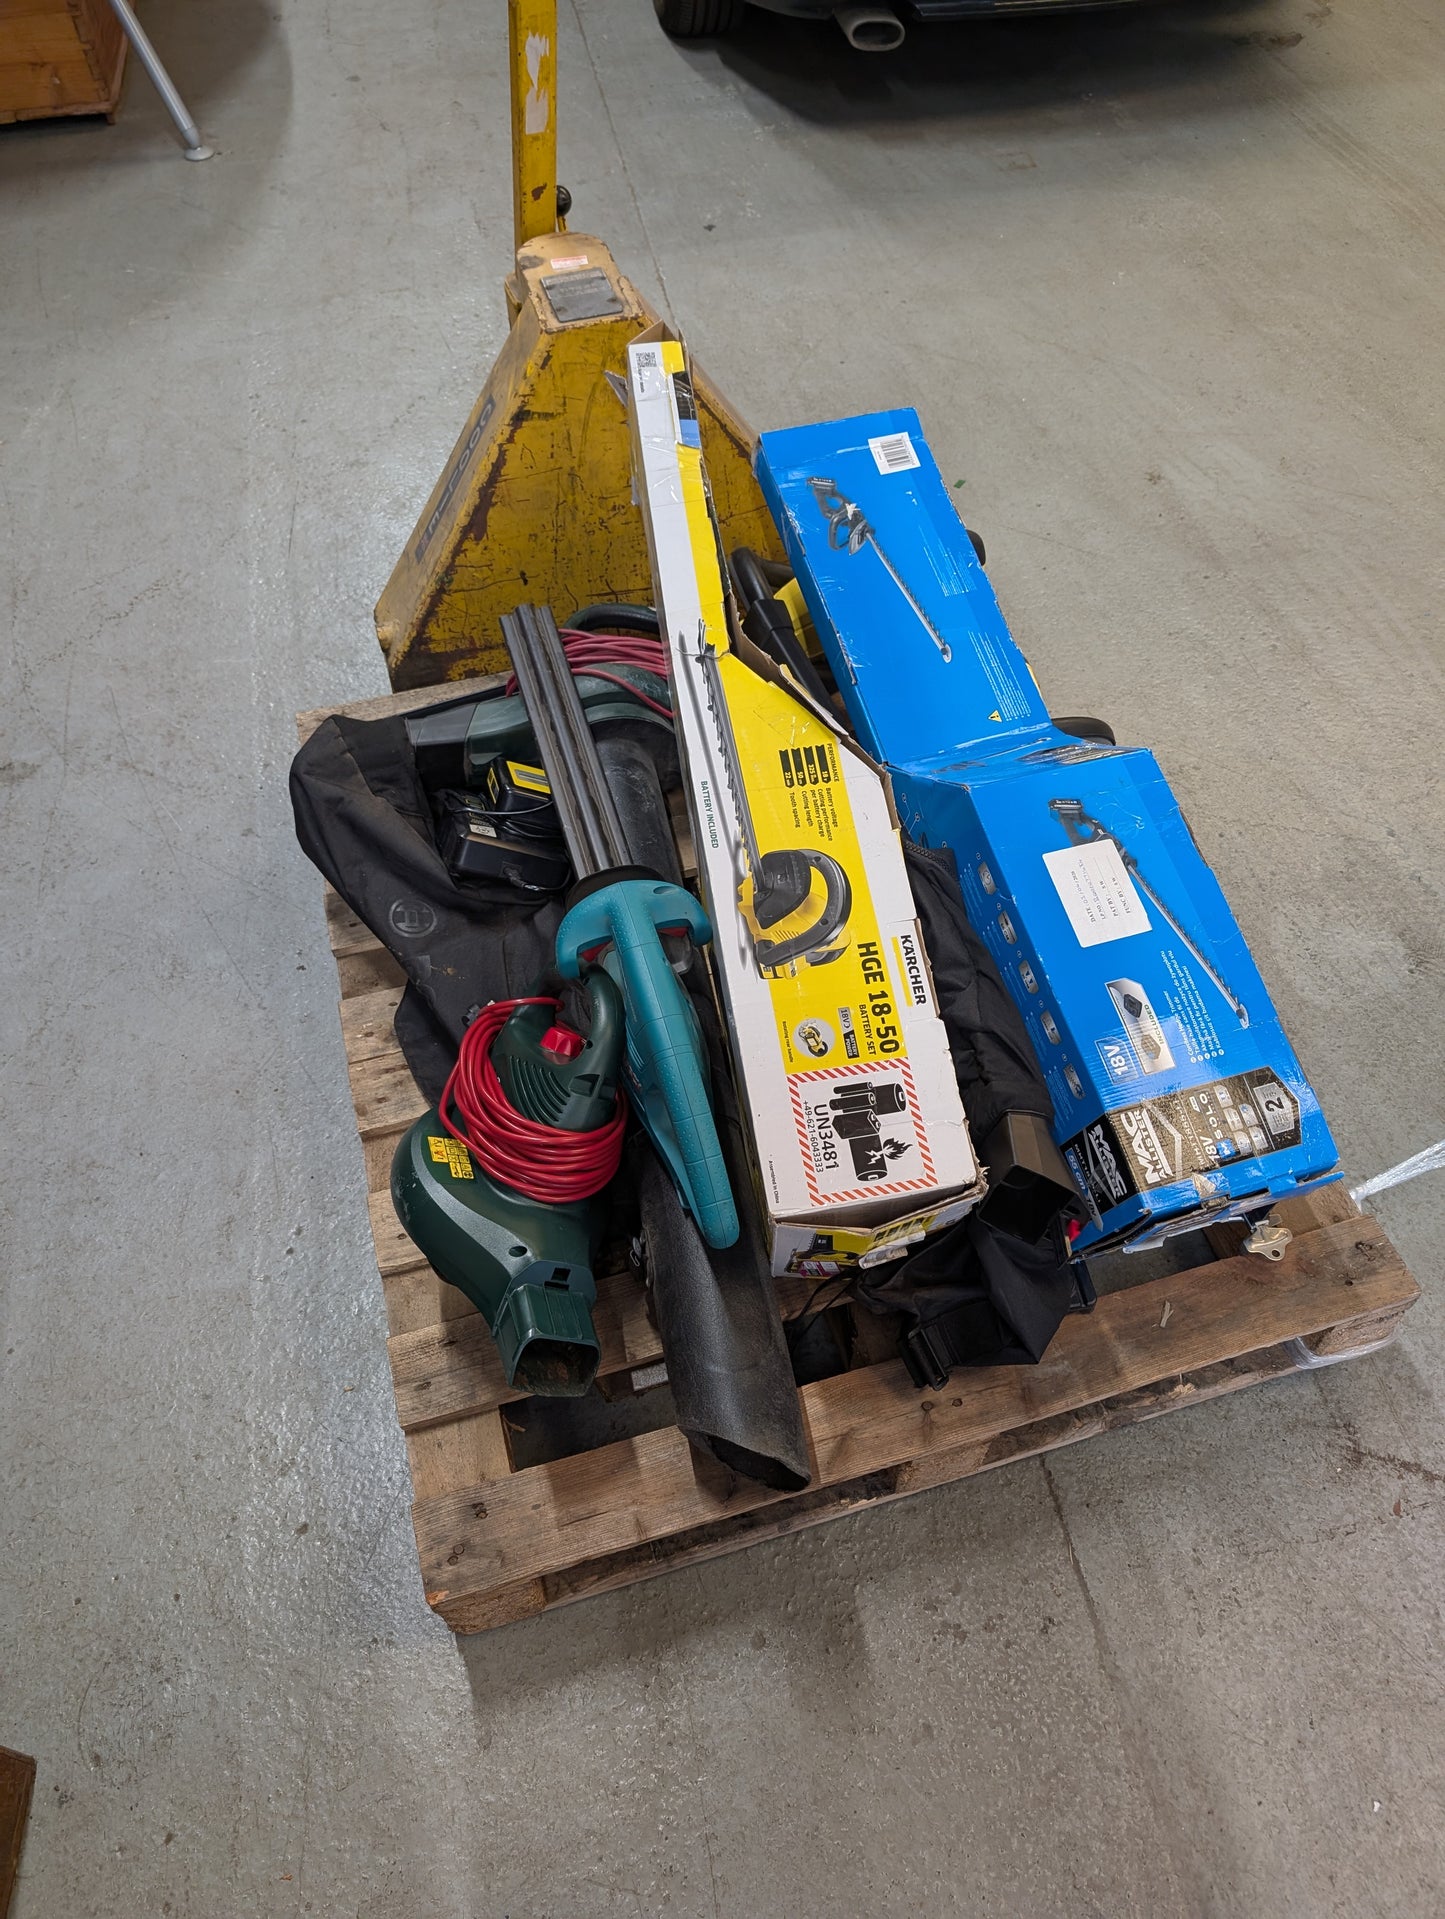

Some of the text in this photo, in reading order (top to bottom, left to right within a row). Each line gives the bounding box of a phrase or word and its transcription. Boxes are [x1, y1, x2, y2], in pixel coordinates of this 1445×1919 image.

[785, 771, 791, 779] 22
[822, 770, 829, 778] 18
[826, 743, 840, 782] PERFORMANCE
[700, 780, 719, 849] BATTERY INCLUDED
[789, 792, 802, 828] Tooth spacing
[801, 790, 814, 827] Cutting length
[812, 799, 822, 819] battery
[817, 788, 833, 841] Cutting performance
[825, 787, 839, 828] Battery voltage
[816, 819, 826, 838] charge
[900, 934, 927, 1006] KÄRCHER
[1167, 950, 1175, 959] viu
[1171, 958, 1184, 978] gardul
[1182, 965, 1197, 990] makinesi
[857, 940, 900, 1055] HGE 18-50
[1162, 989, 1177, 1013] Trimmer
[1185, 990, 1199, 1010] pentru
[1193, 990, 1207, 1014] budama
[858, 1004, 876, 1056] BATTERY SET
[1144, 1003, 1165, 1045] INCLUDED
[845, 1038, 853, 1057] POWER
[849, 1034, 858, 1056] BATTERY
[1103, 1042, 1129, 1076] 18V
[1199, 1092, 1223, 1140] SOLO
[1264, 1097, 1284, 1113] 2
[802, 1100, 824, 1173] +49-621-6043333
[813, 1103, 840, 1170] UN3481
[1120, 1110, 1162, 1184] MAC
[1133, 1109, 1167, 1180] ALLISTER
[768, 1160, 777, 1185] Assembled
[1093, 1124, 1128, 1196] MAC
[1075, 1171, 1086, 1190] cm
